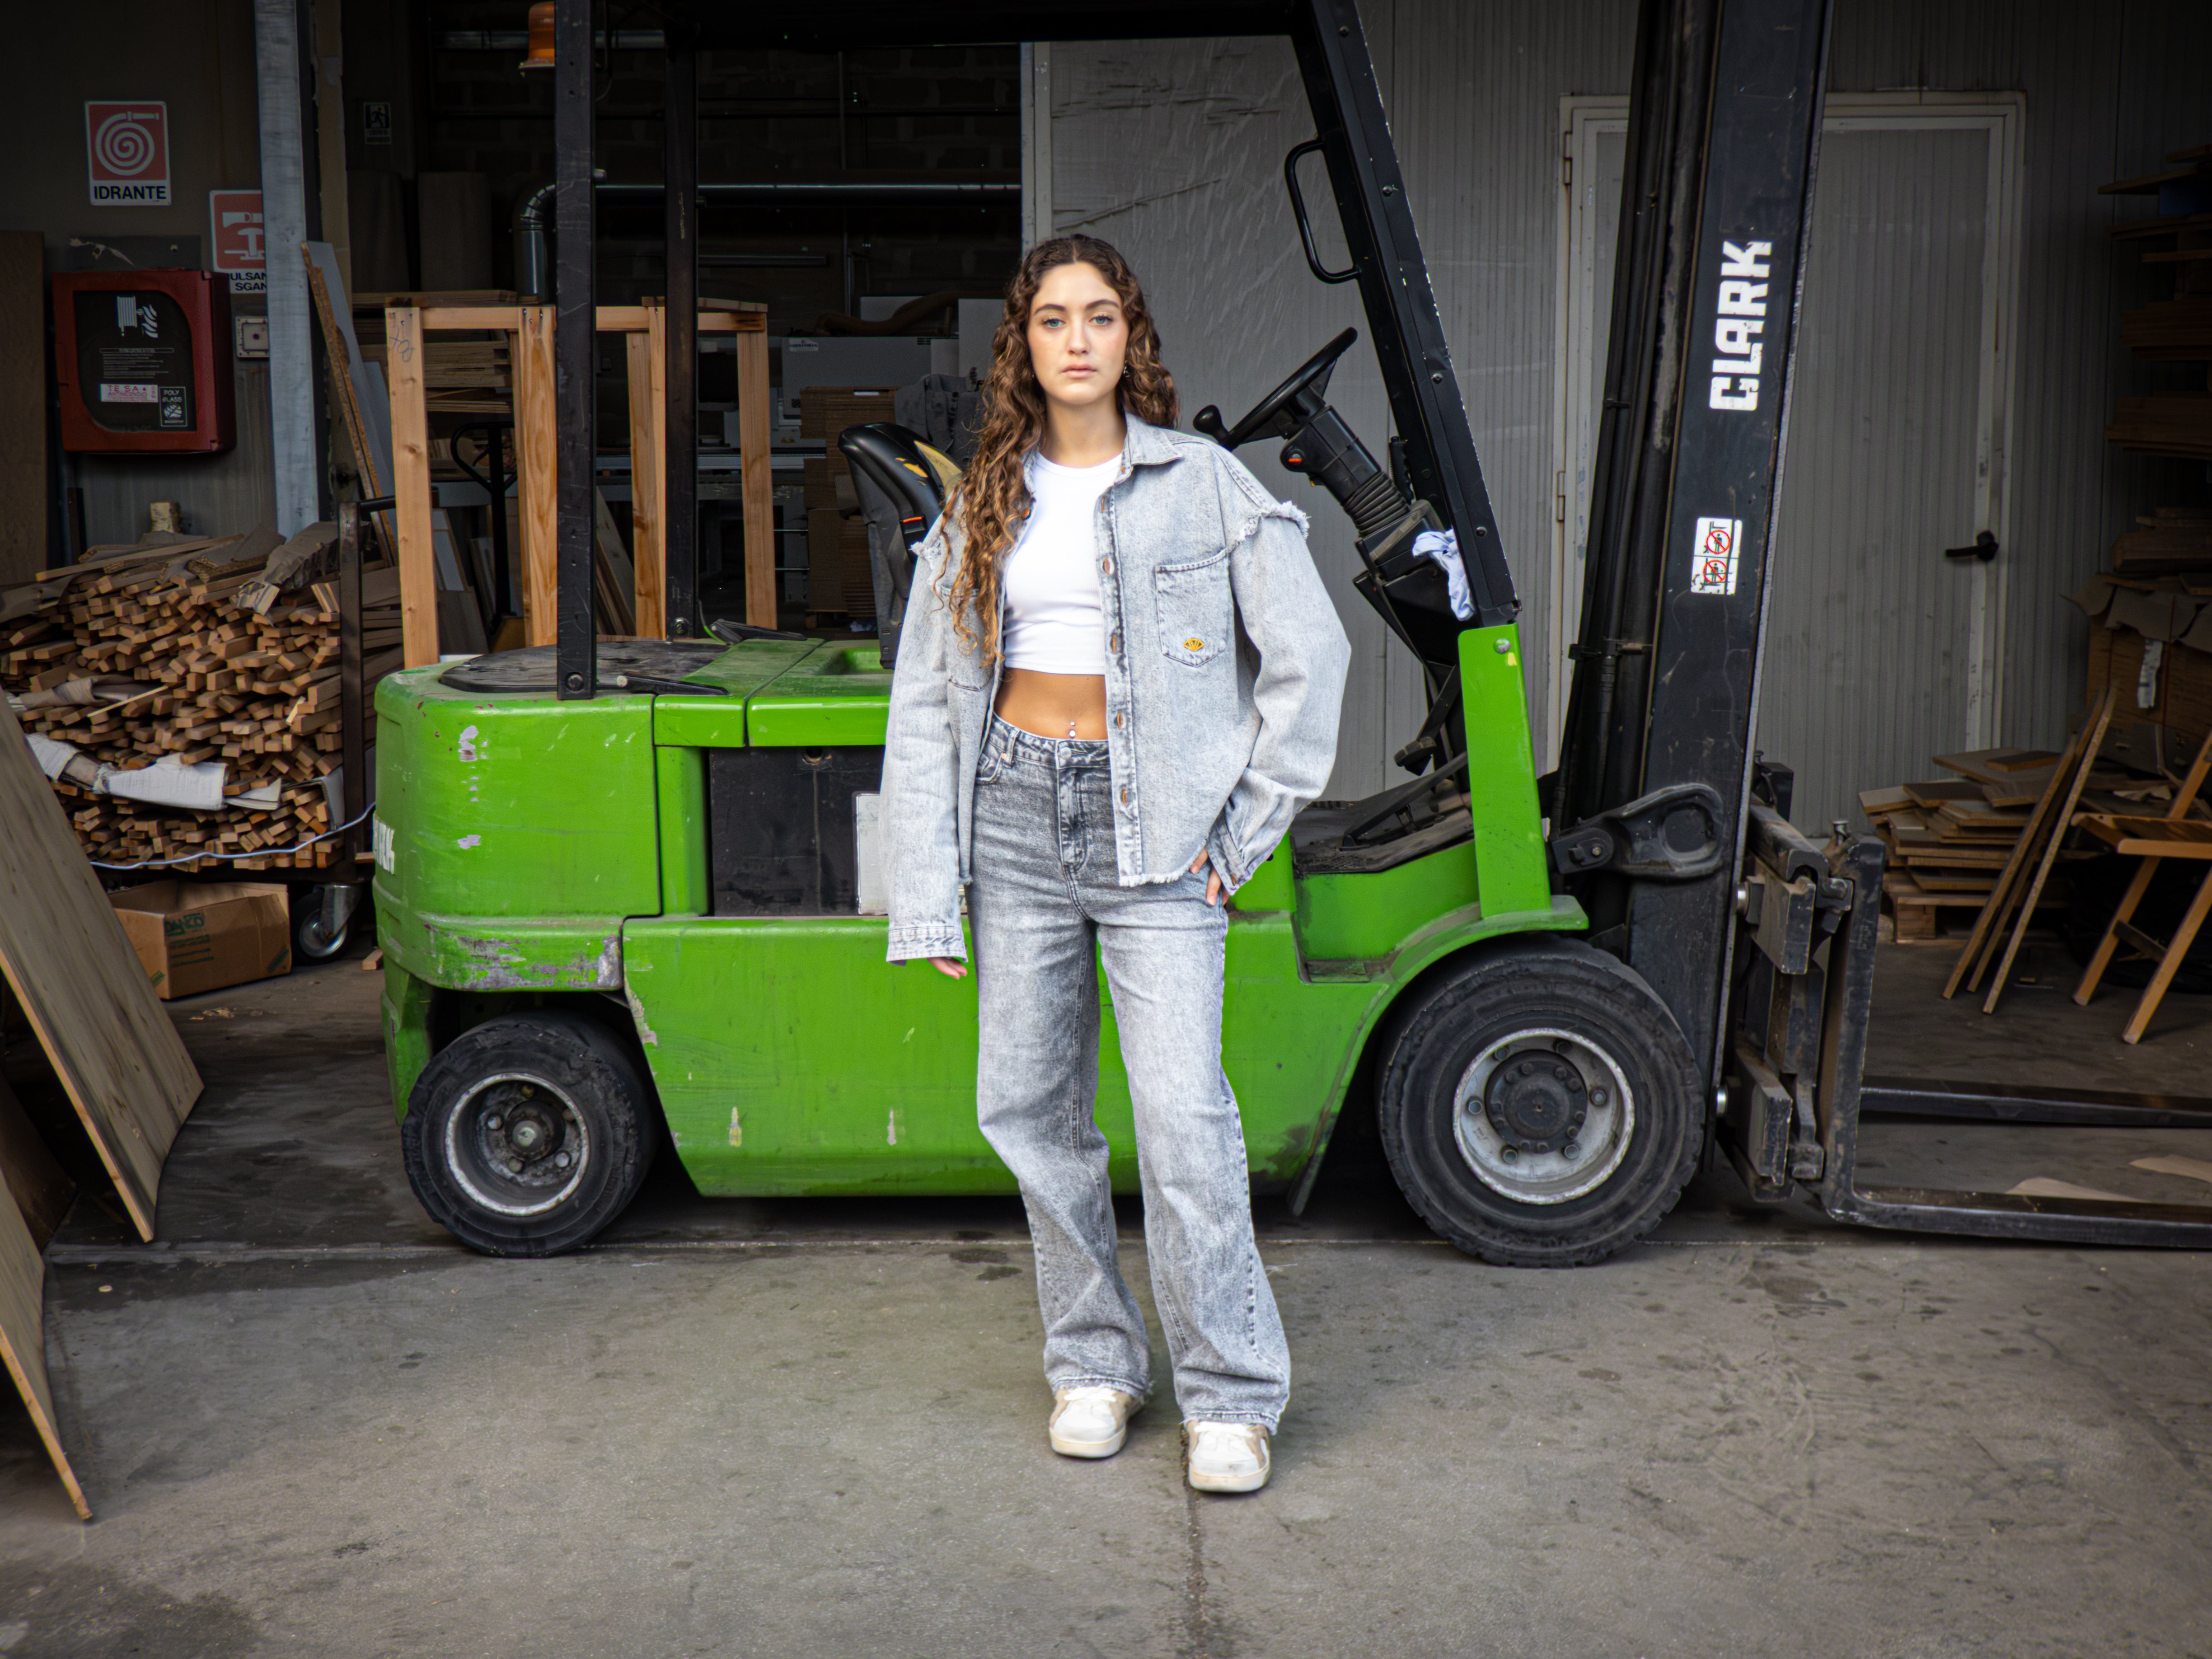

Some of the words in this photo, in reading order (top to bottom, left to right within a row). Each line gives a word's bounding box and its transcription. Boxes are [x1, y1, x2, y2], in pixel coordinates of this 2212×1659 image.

[94, 186, 167, 199] IDRANTE
[230, 272, 267, 281] ULSAN
[234, 282, 267, 291] SGAN
[1709, 240, 1772, 411] CLARK
